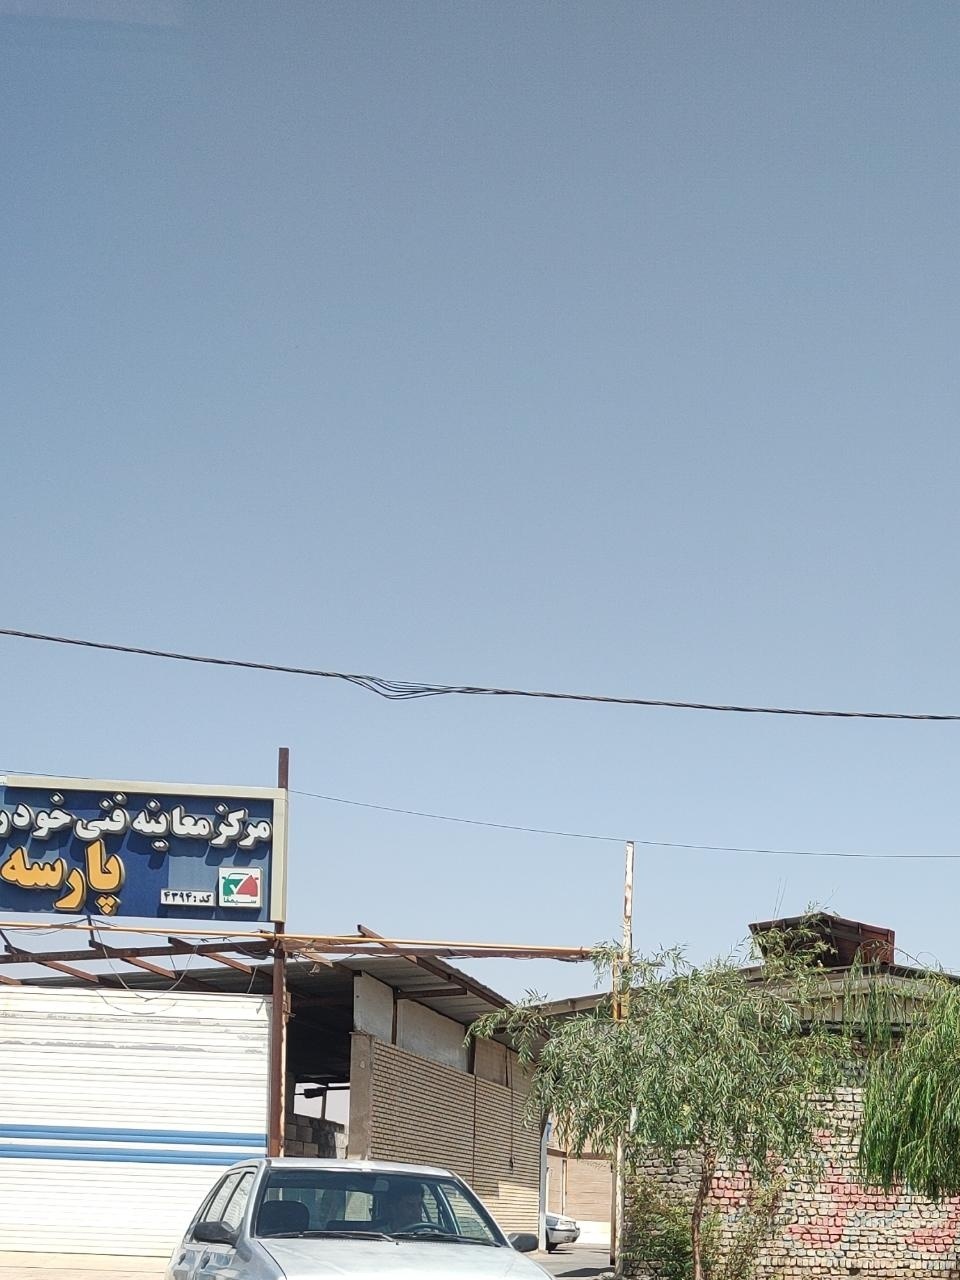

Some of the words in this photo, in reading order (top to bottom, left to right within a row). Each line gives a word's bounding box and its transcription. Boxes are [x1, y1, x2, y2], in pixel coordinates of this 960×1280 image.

[74, 792, 129, 841] فنی
[131, 799, 214, 852] معاینه
[209, 803, 271, 849] مرکز
[0, 838, 125, 917] پارسه
